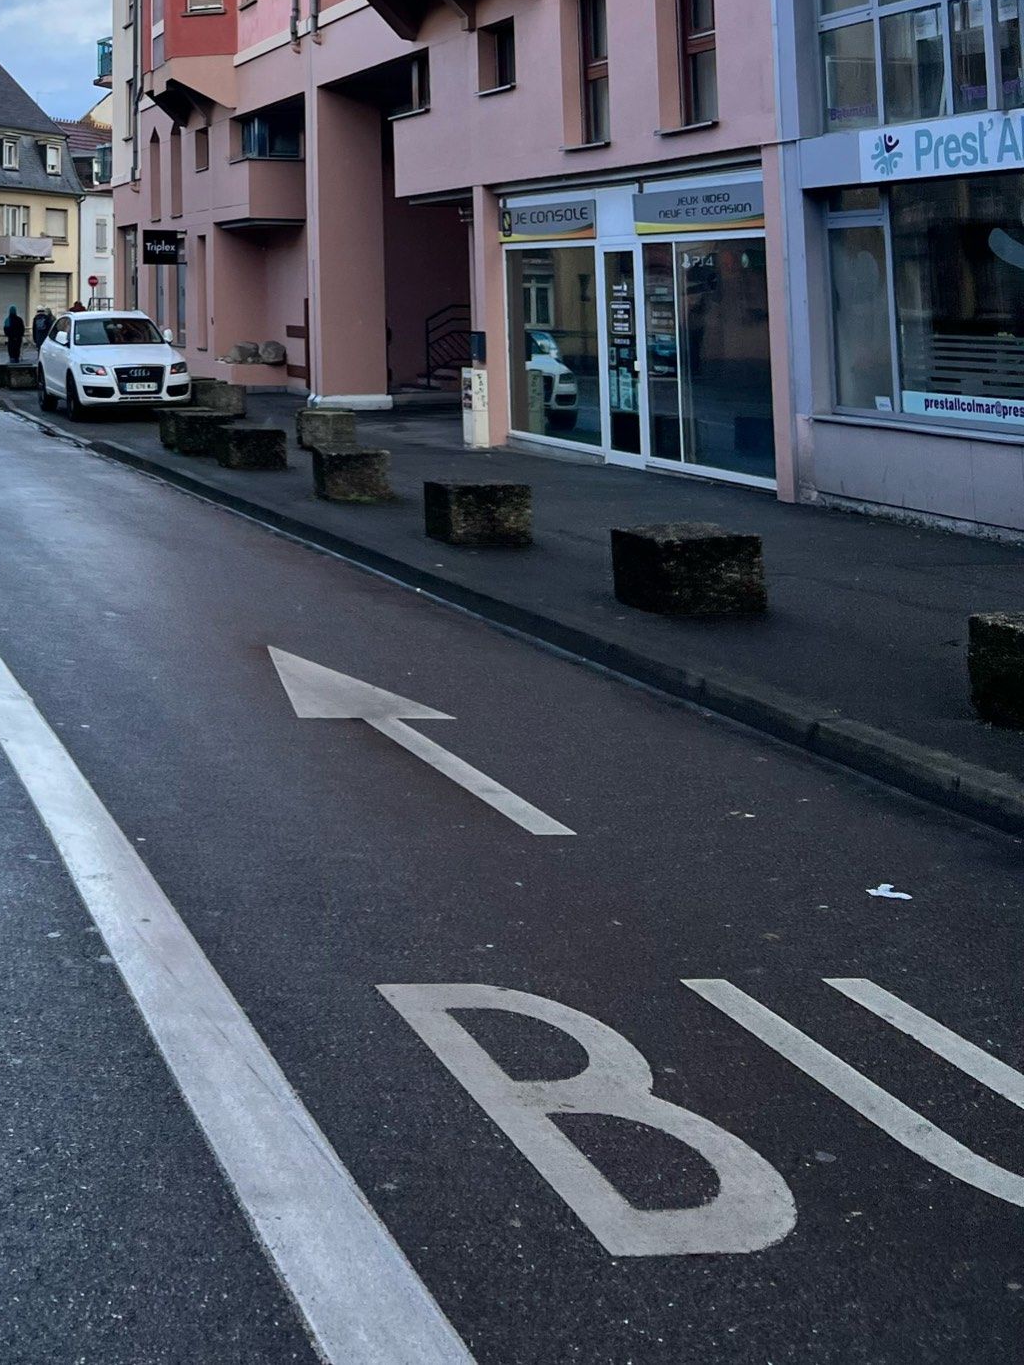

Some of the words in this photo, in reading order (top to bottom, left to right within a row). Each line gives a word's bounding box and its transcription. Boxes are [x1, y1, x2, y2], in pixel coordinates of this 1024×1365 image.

[676, 195, 698, 206] JEUX
[702, 192, 730, 204] VIDEO
[515, 212, 527, 225] JE
[685, 207, 696, 217] ET
[145, 239, 176, 255] Triplex
[691, 255, 714, 267] PS4
